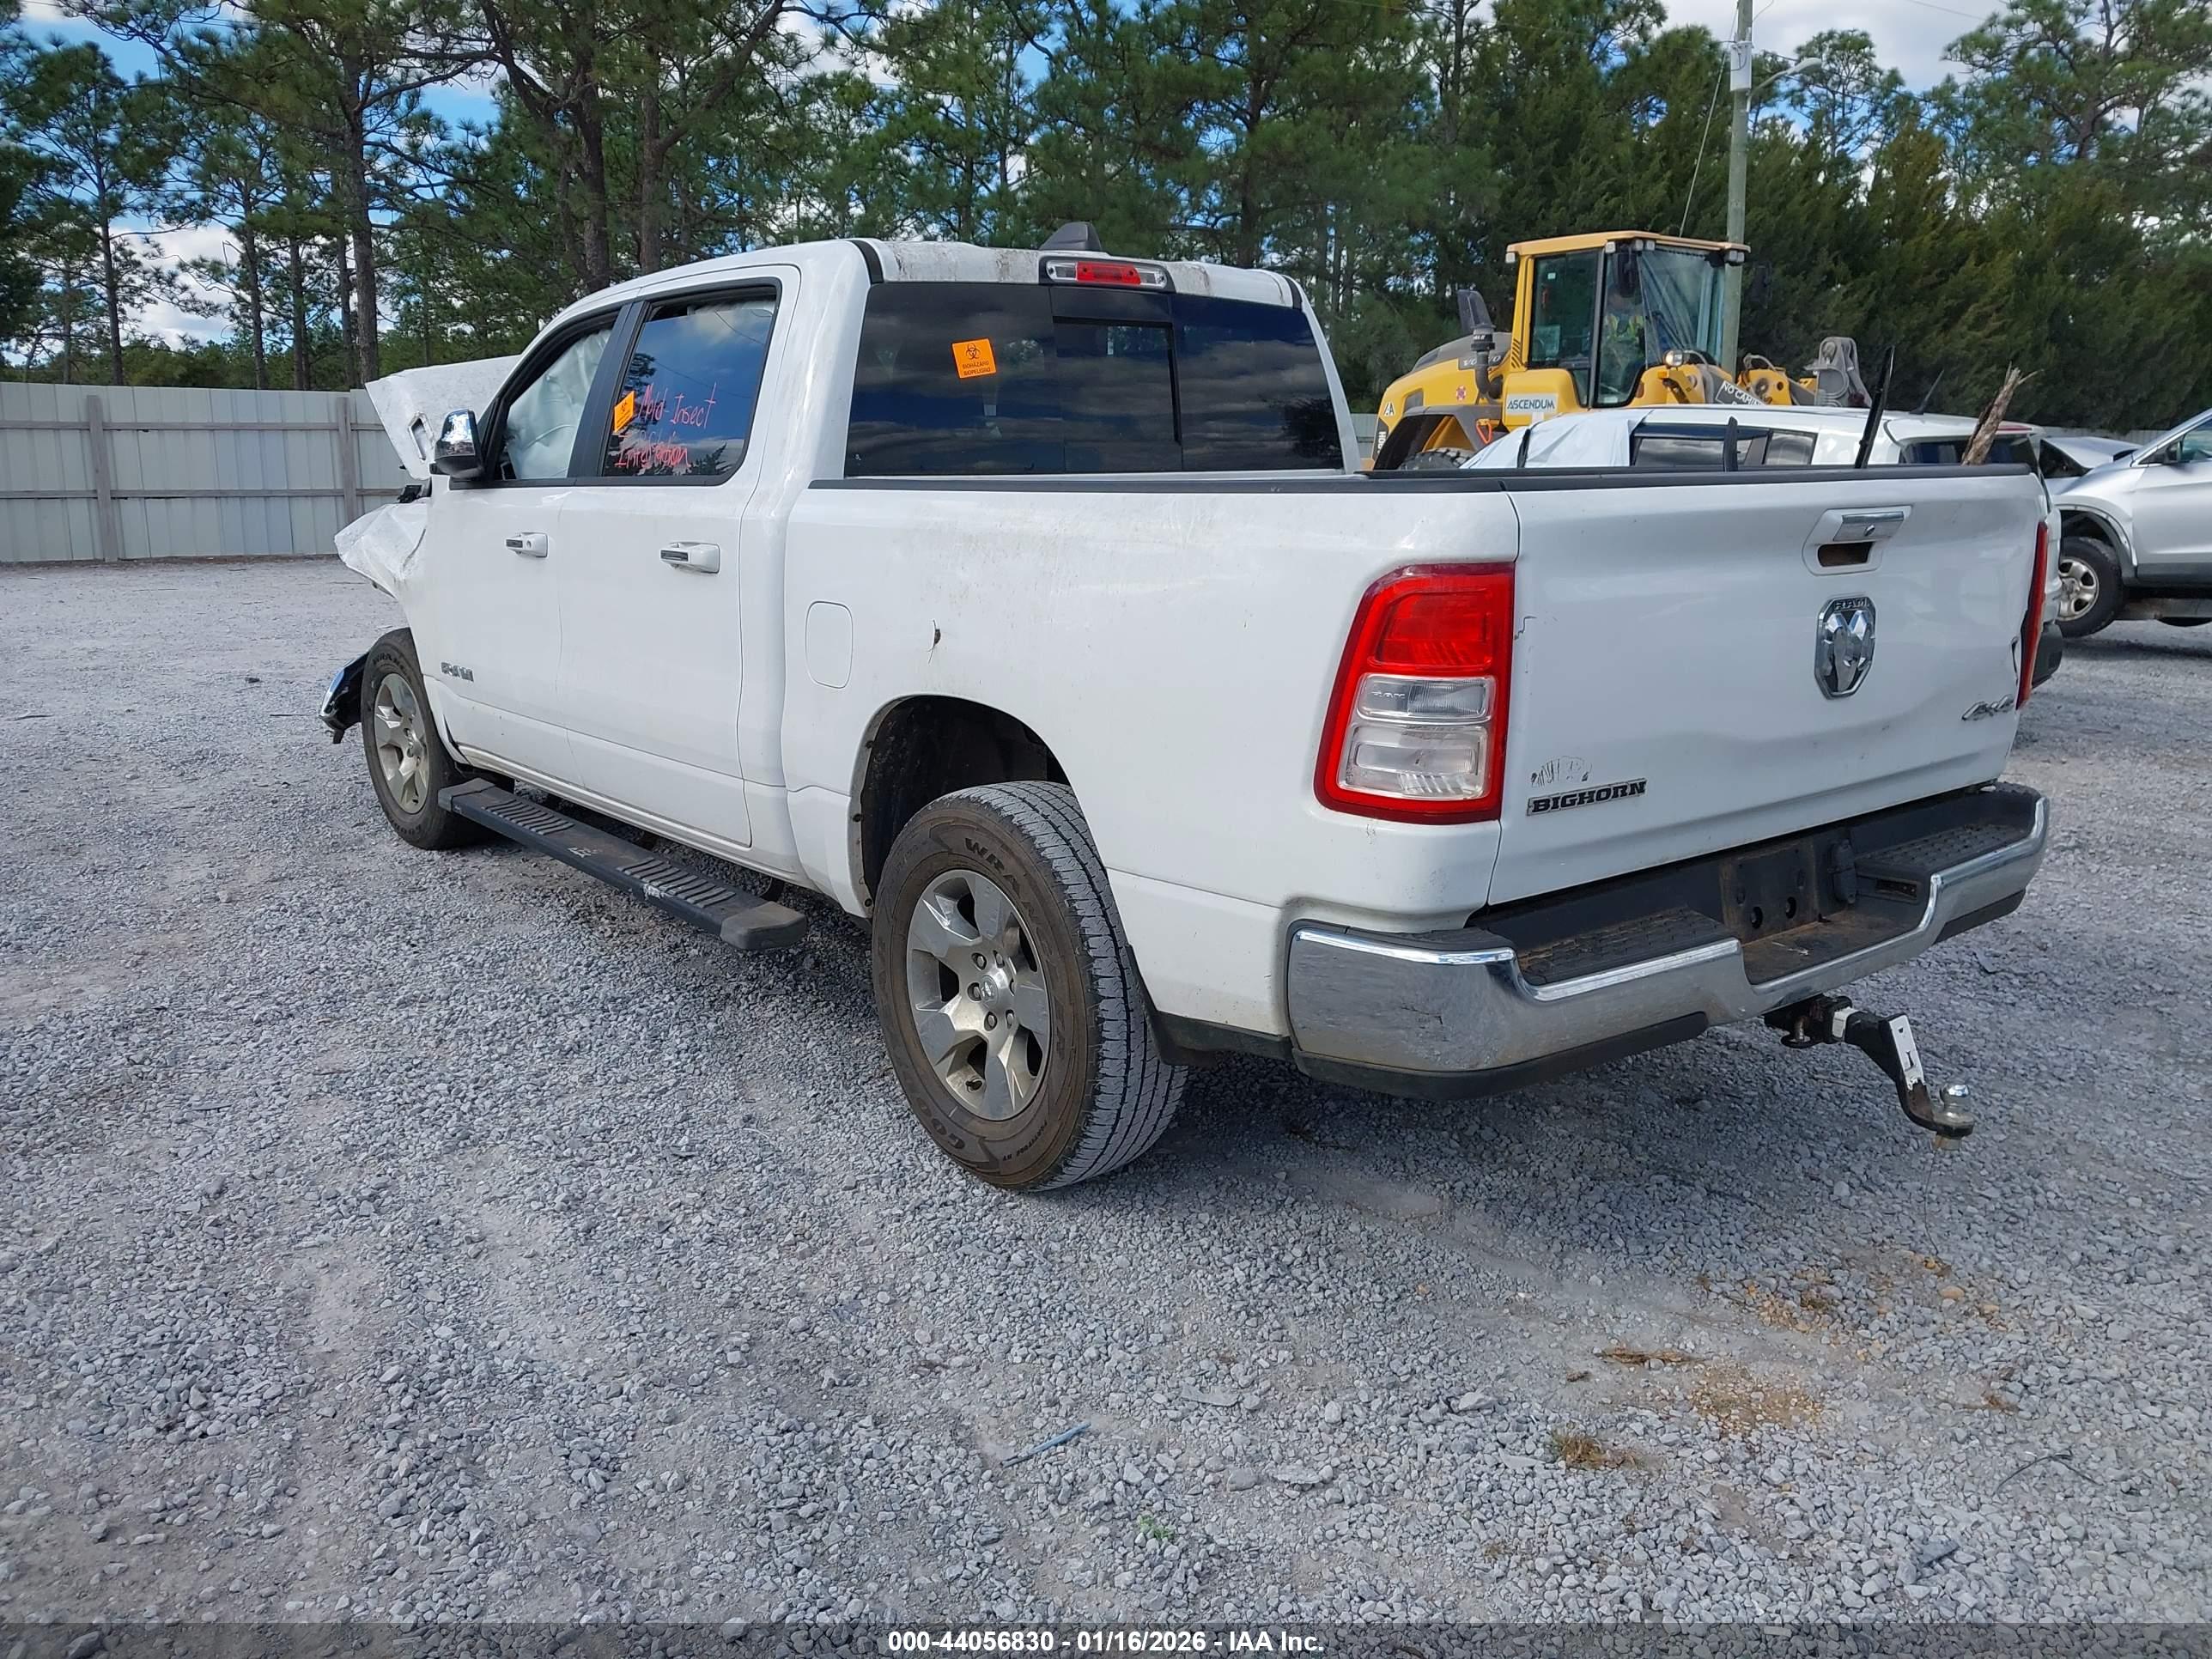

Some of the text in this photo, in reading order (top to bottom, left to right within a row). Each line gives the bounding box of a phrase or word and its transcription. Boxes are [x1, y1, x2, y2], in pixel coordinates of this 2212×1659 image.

[670, 381, 718, 429] Insect
[1507, 398, 1555, 410] ASCENDUM
[1833, 597, 1869, 611] RAM
[441, 661, 475, 683] RAM
